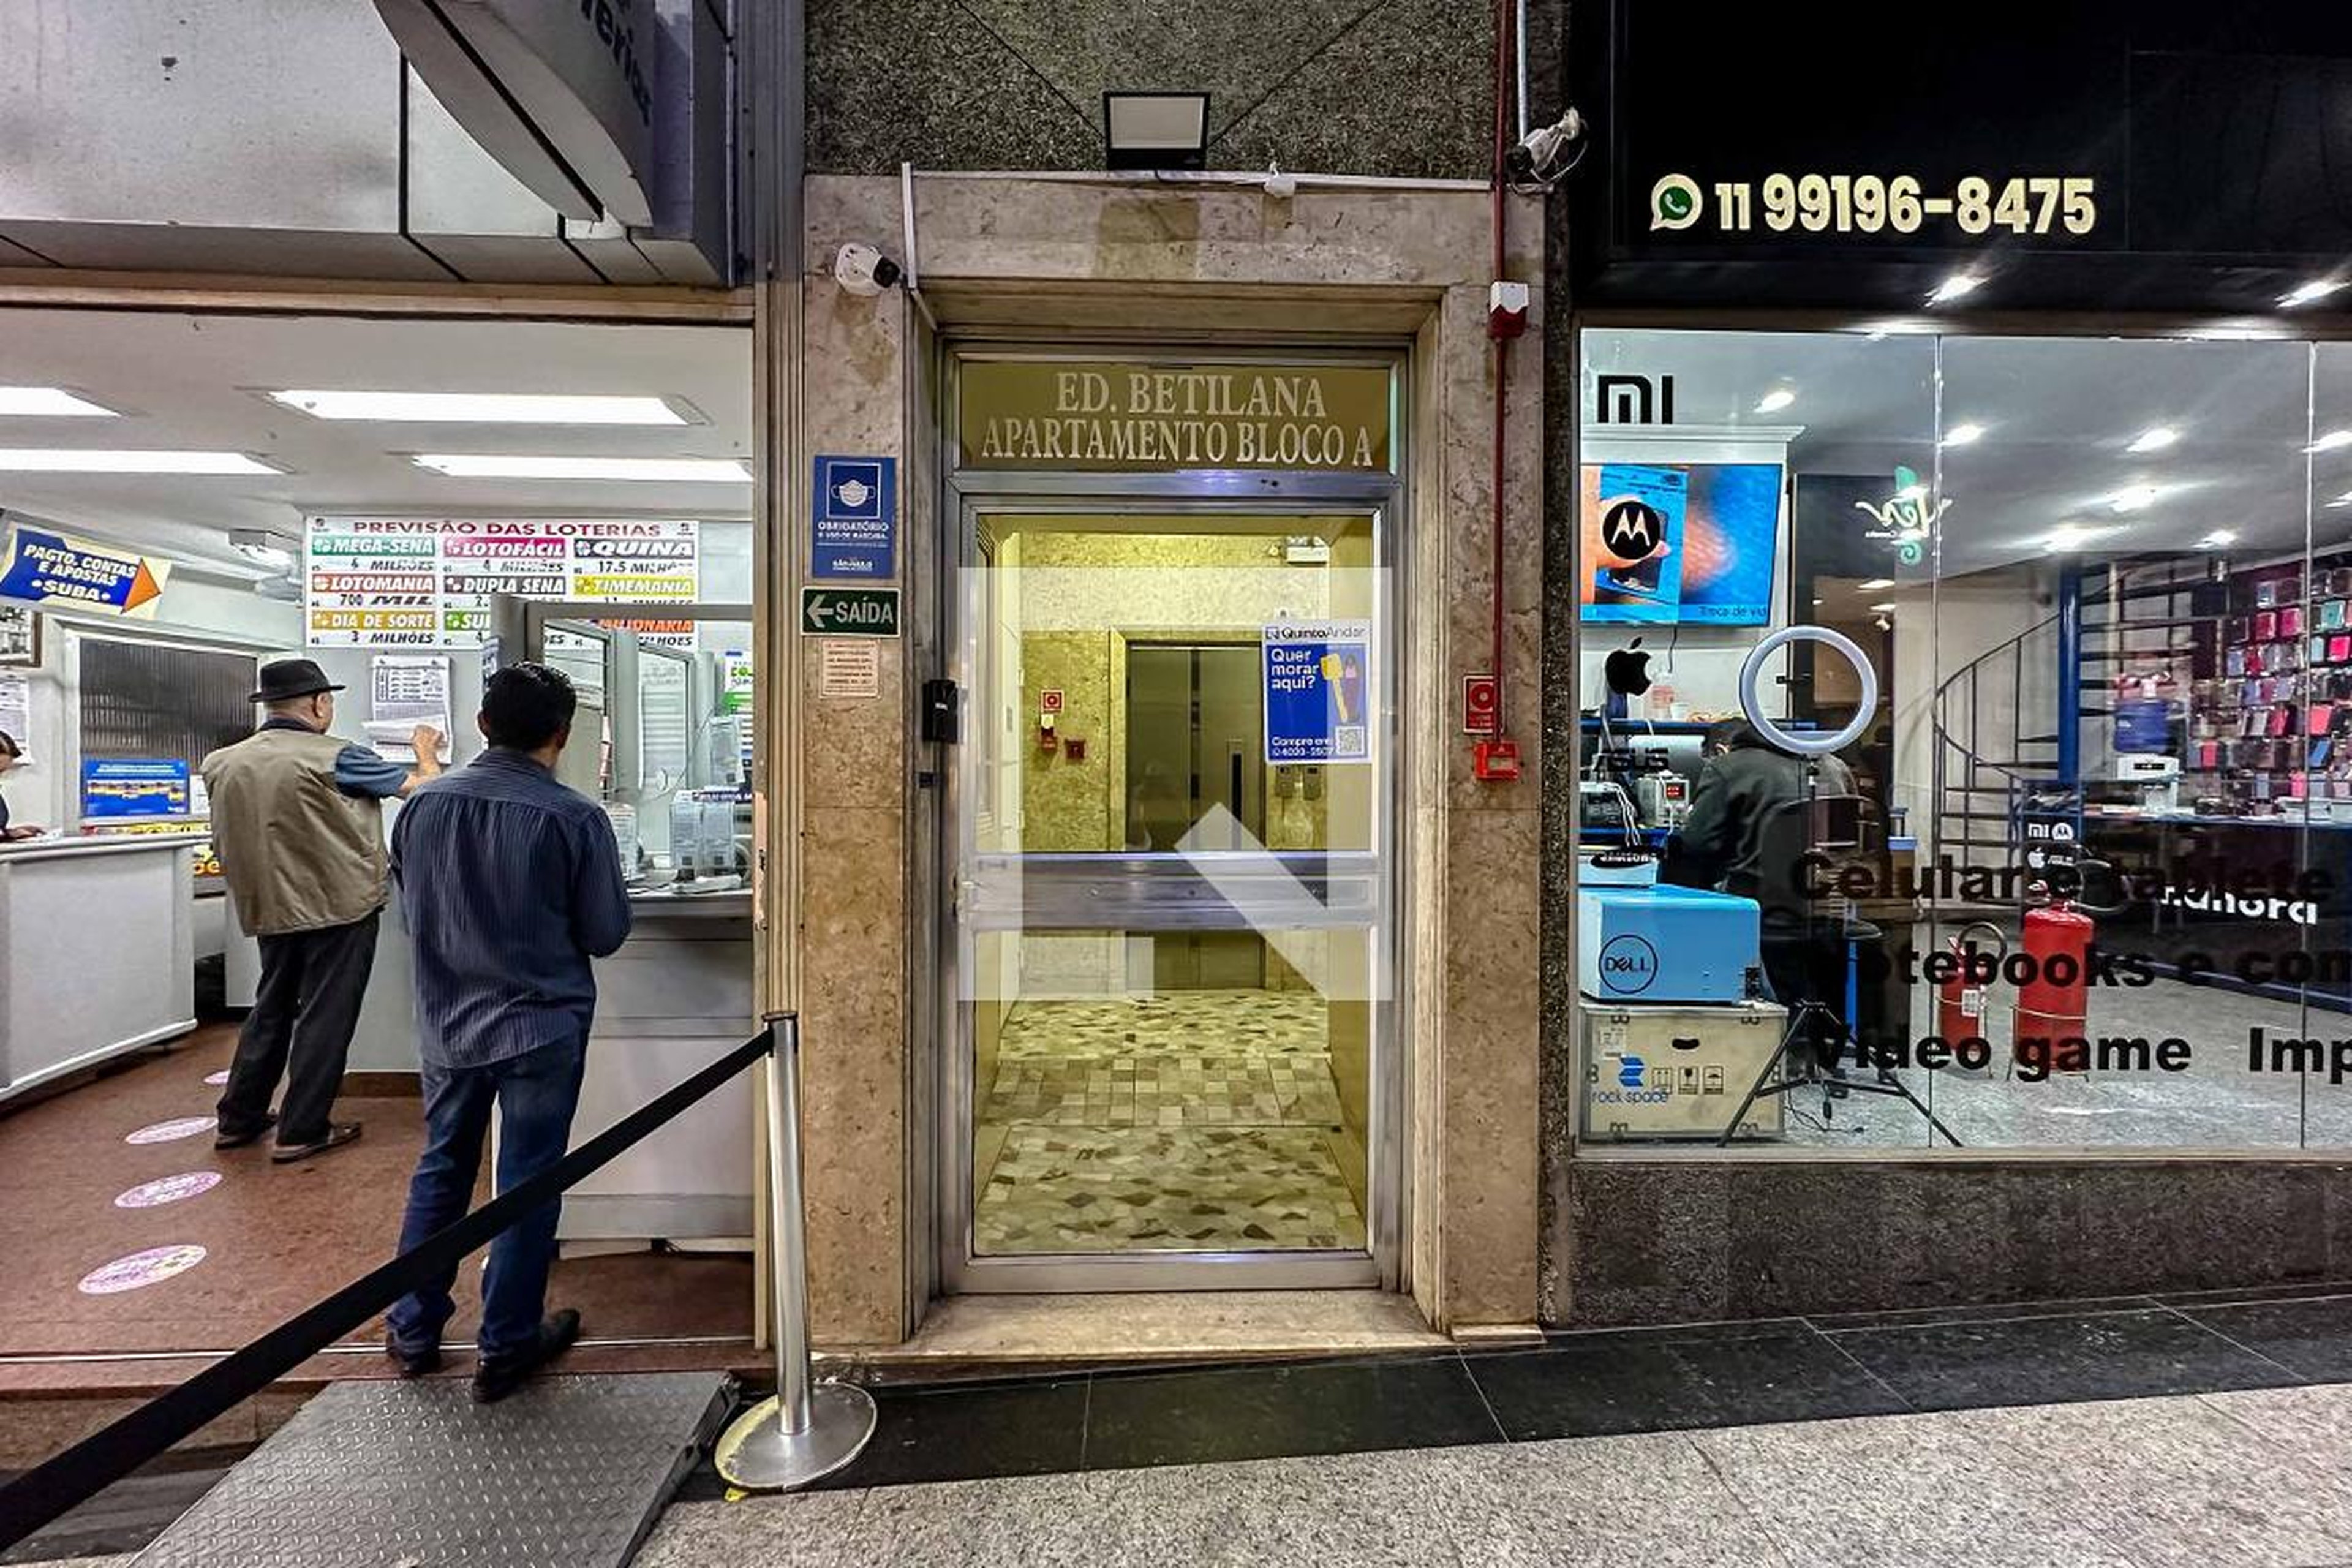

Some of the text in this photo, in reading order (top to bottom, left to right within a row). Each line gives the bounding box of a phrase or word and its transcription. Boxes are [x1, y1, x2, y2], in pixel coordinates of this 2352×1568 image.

[1715, 173, 2096, 235] 11 99196-8475
[1056, 372, 1327, 418] ED. BETILANA
[982, 418, 1373, 467] APARTAMENTO BLOCO A
[354, 520, 661, 537] PREVISÃO DAS LOTERIAS
[334, 538, 434, 554] MEGA-SENA
[461, 539, 564, 556] LOTOFÁCIL
[592, 540, 693, 557] QUINA
[24, 544, 138, 578] PAGTO. CONTAS
[599, 560, 693, 574] 17.5 MILH
[37, 561, 119, 587] E APOSTAS
[42, 579, 100, 601] SUBA
[330, 577, 434, 591] LOTOMANIA
[464, 577, 565, 594] DUPLA SENA
[594, 579, 692, 594] TIMEMANIA
[340, 594, 363, 606] 700
[835, 597, 894, 625] SAÍDA
[332, 614, 434, 628] DIA DE SORTE
[1271, 648, 1311, 662] Quer
[1271, 664, 1320, 676] morar
[1271, 675, 1316, 693] aqui?
[1794, 854, 2023, 899] Celular
[1605, 957, 1651, 971] DELL
[1808, 942, 2155, 988] otebooks
[2014, 1038, 2192, 1083] game
